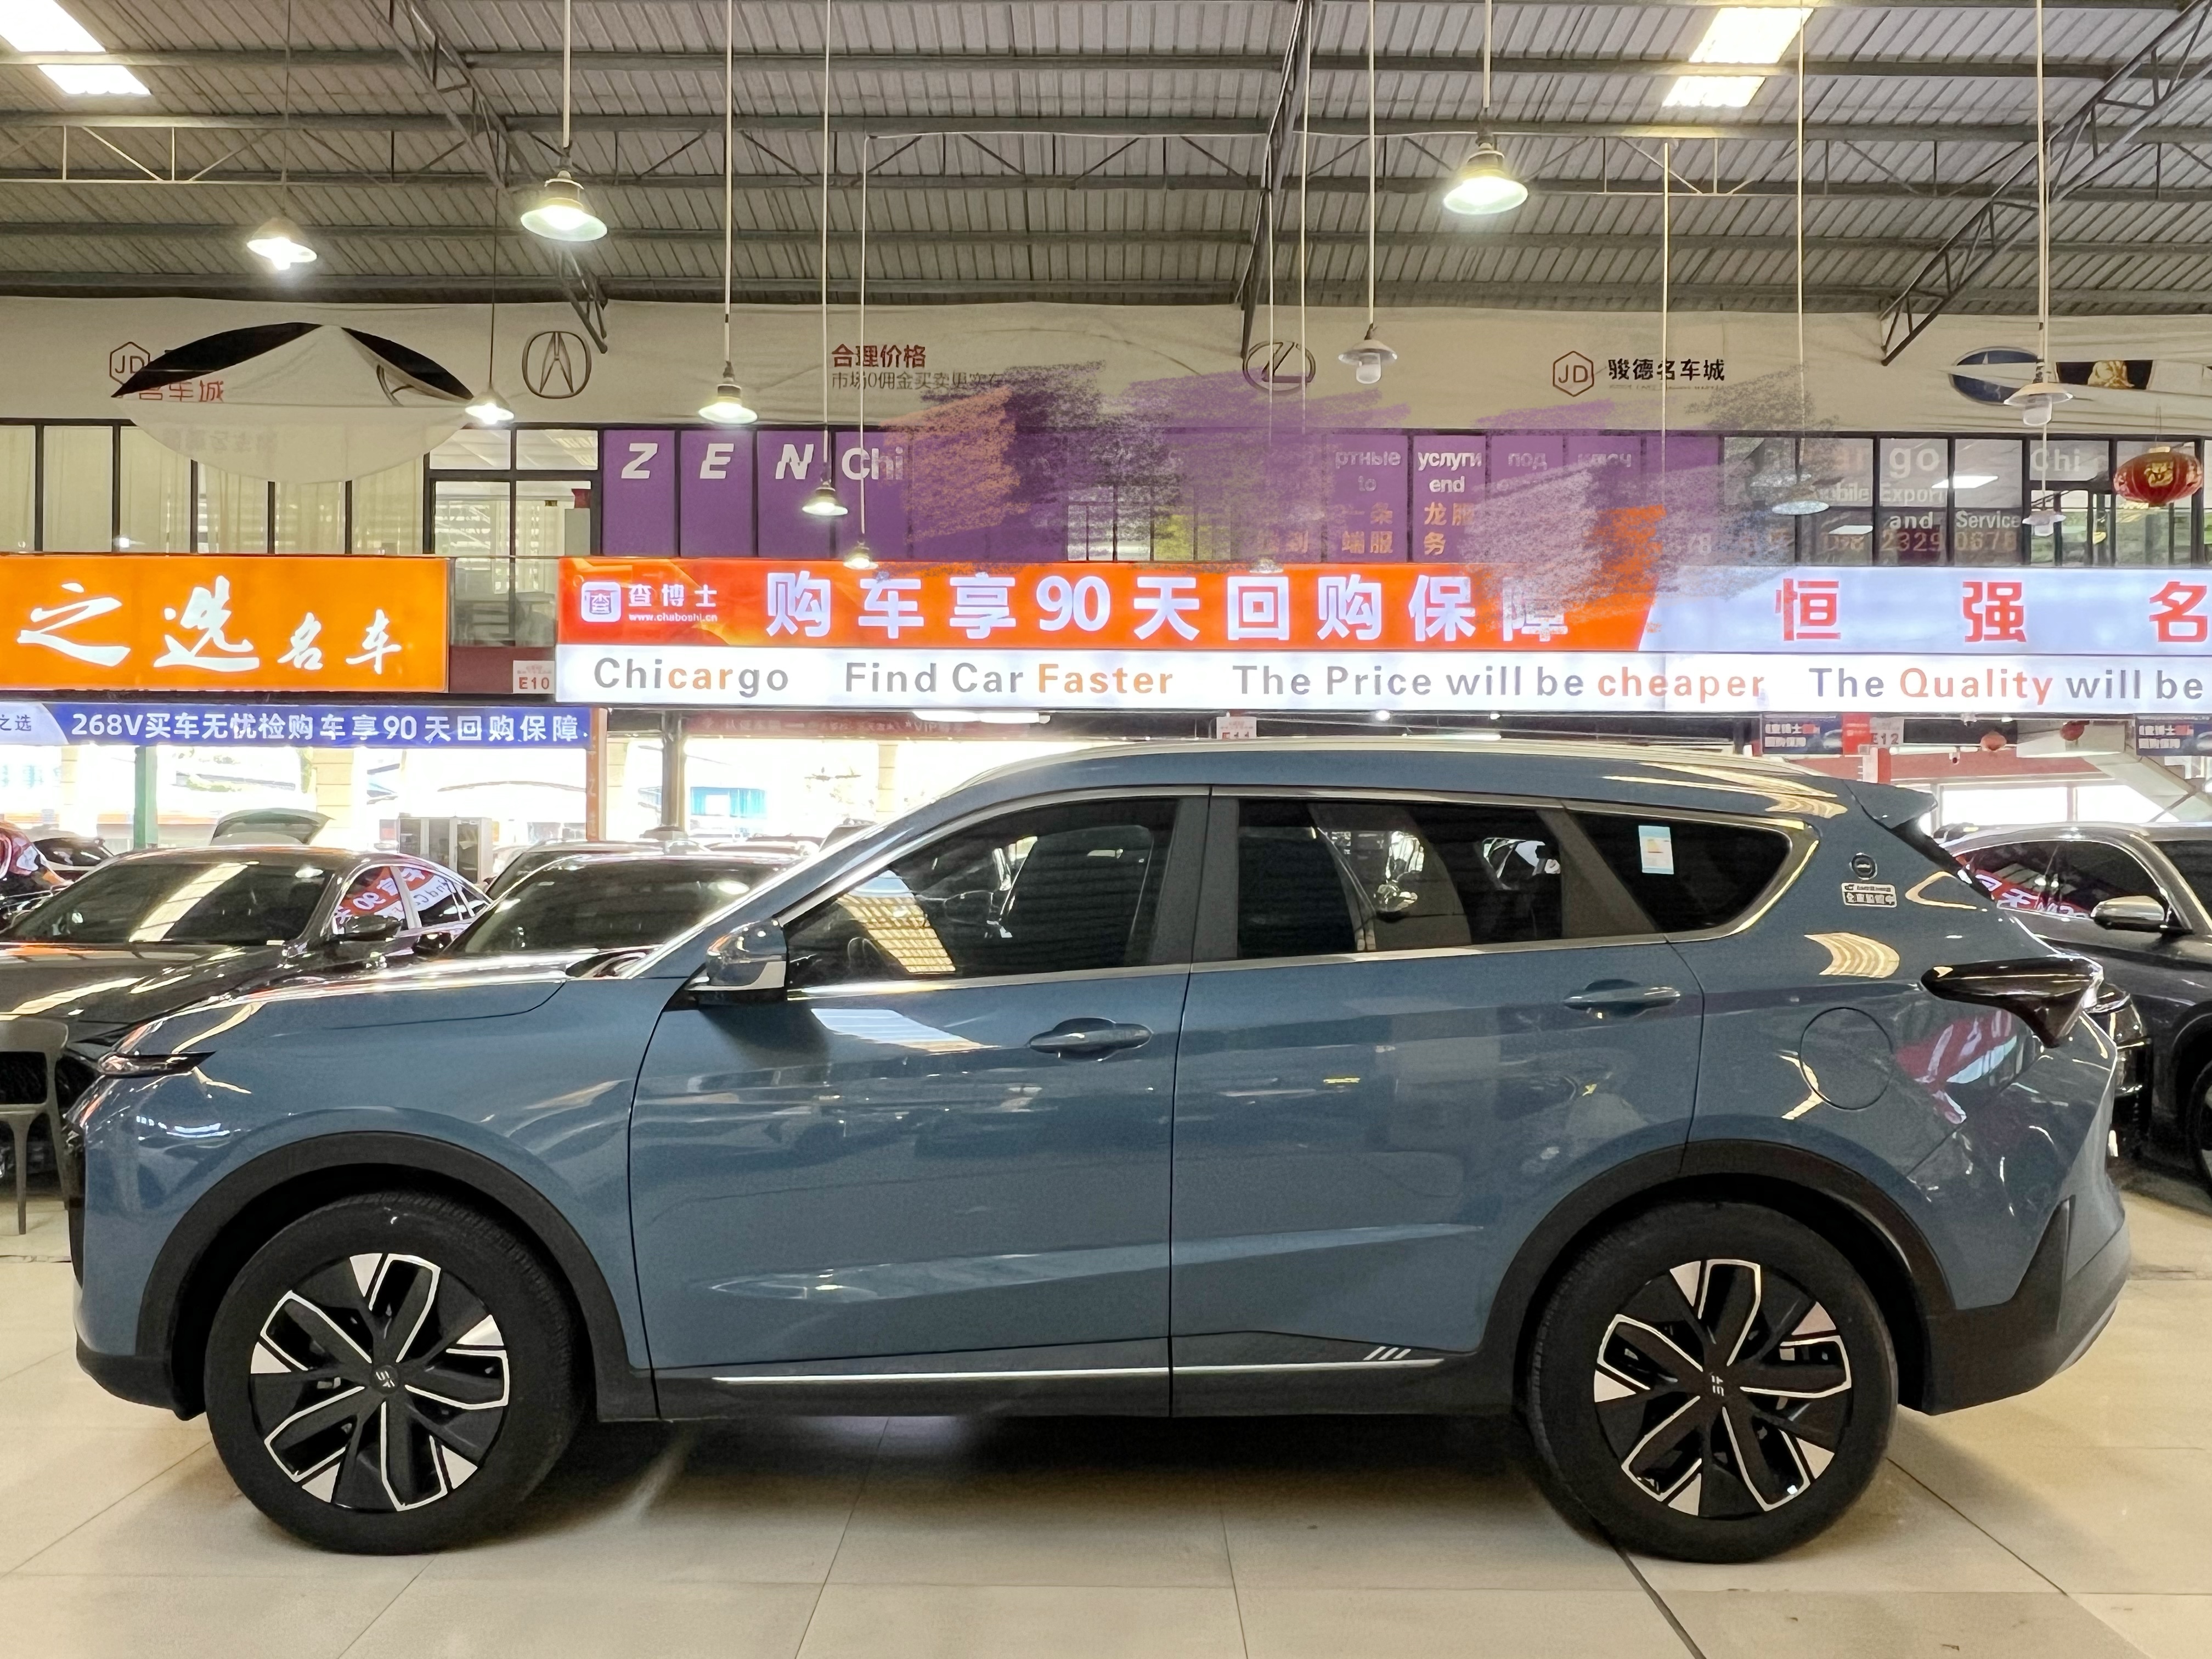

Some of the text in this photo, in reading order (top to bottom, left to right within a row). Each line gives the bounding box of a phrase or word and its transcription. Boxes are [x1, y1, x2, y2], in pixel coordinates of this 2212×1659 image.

[831, 343, 926, 368] 合理价格
[1558, 364, 1588, 383] JD
[1608, 358, 1725, 381] 骏德名车城
[1417, 452, 1482, 471] услуги
[1508, 453, 1548, 470] под
[1889, 447, 1940, 478] go
[1429, 475, 1465, 493] end
[1889, 510, 2021, 529] and Service
[628, 584, 718, 607] 查博士
[518, 676, 550, 690] E10
[594, 657, 2203, 706] Chicargo Find Car Faster The Price will be cheaper The Quality will be
